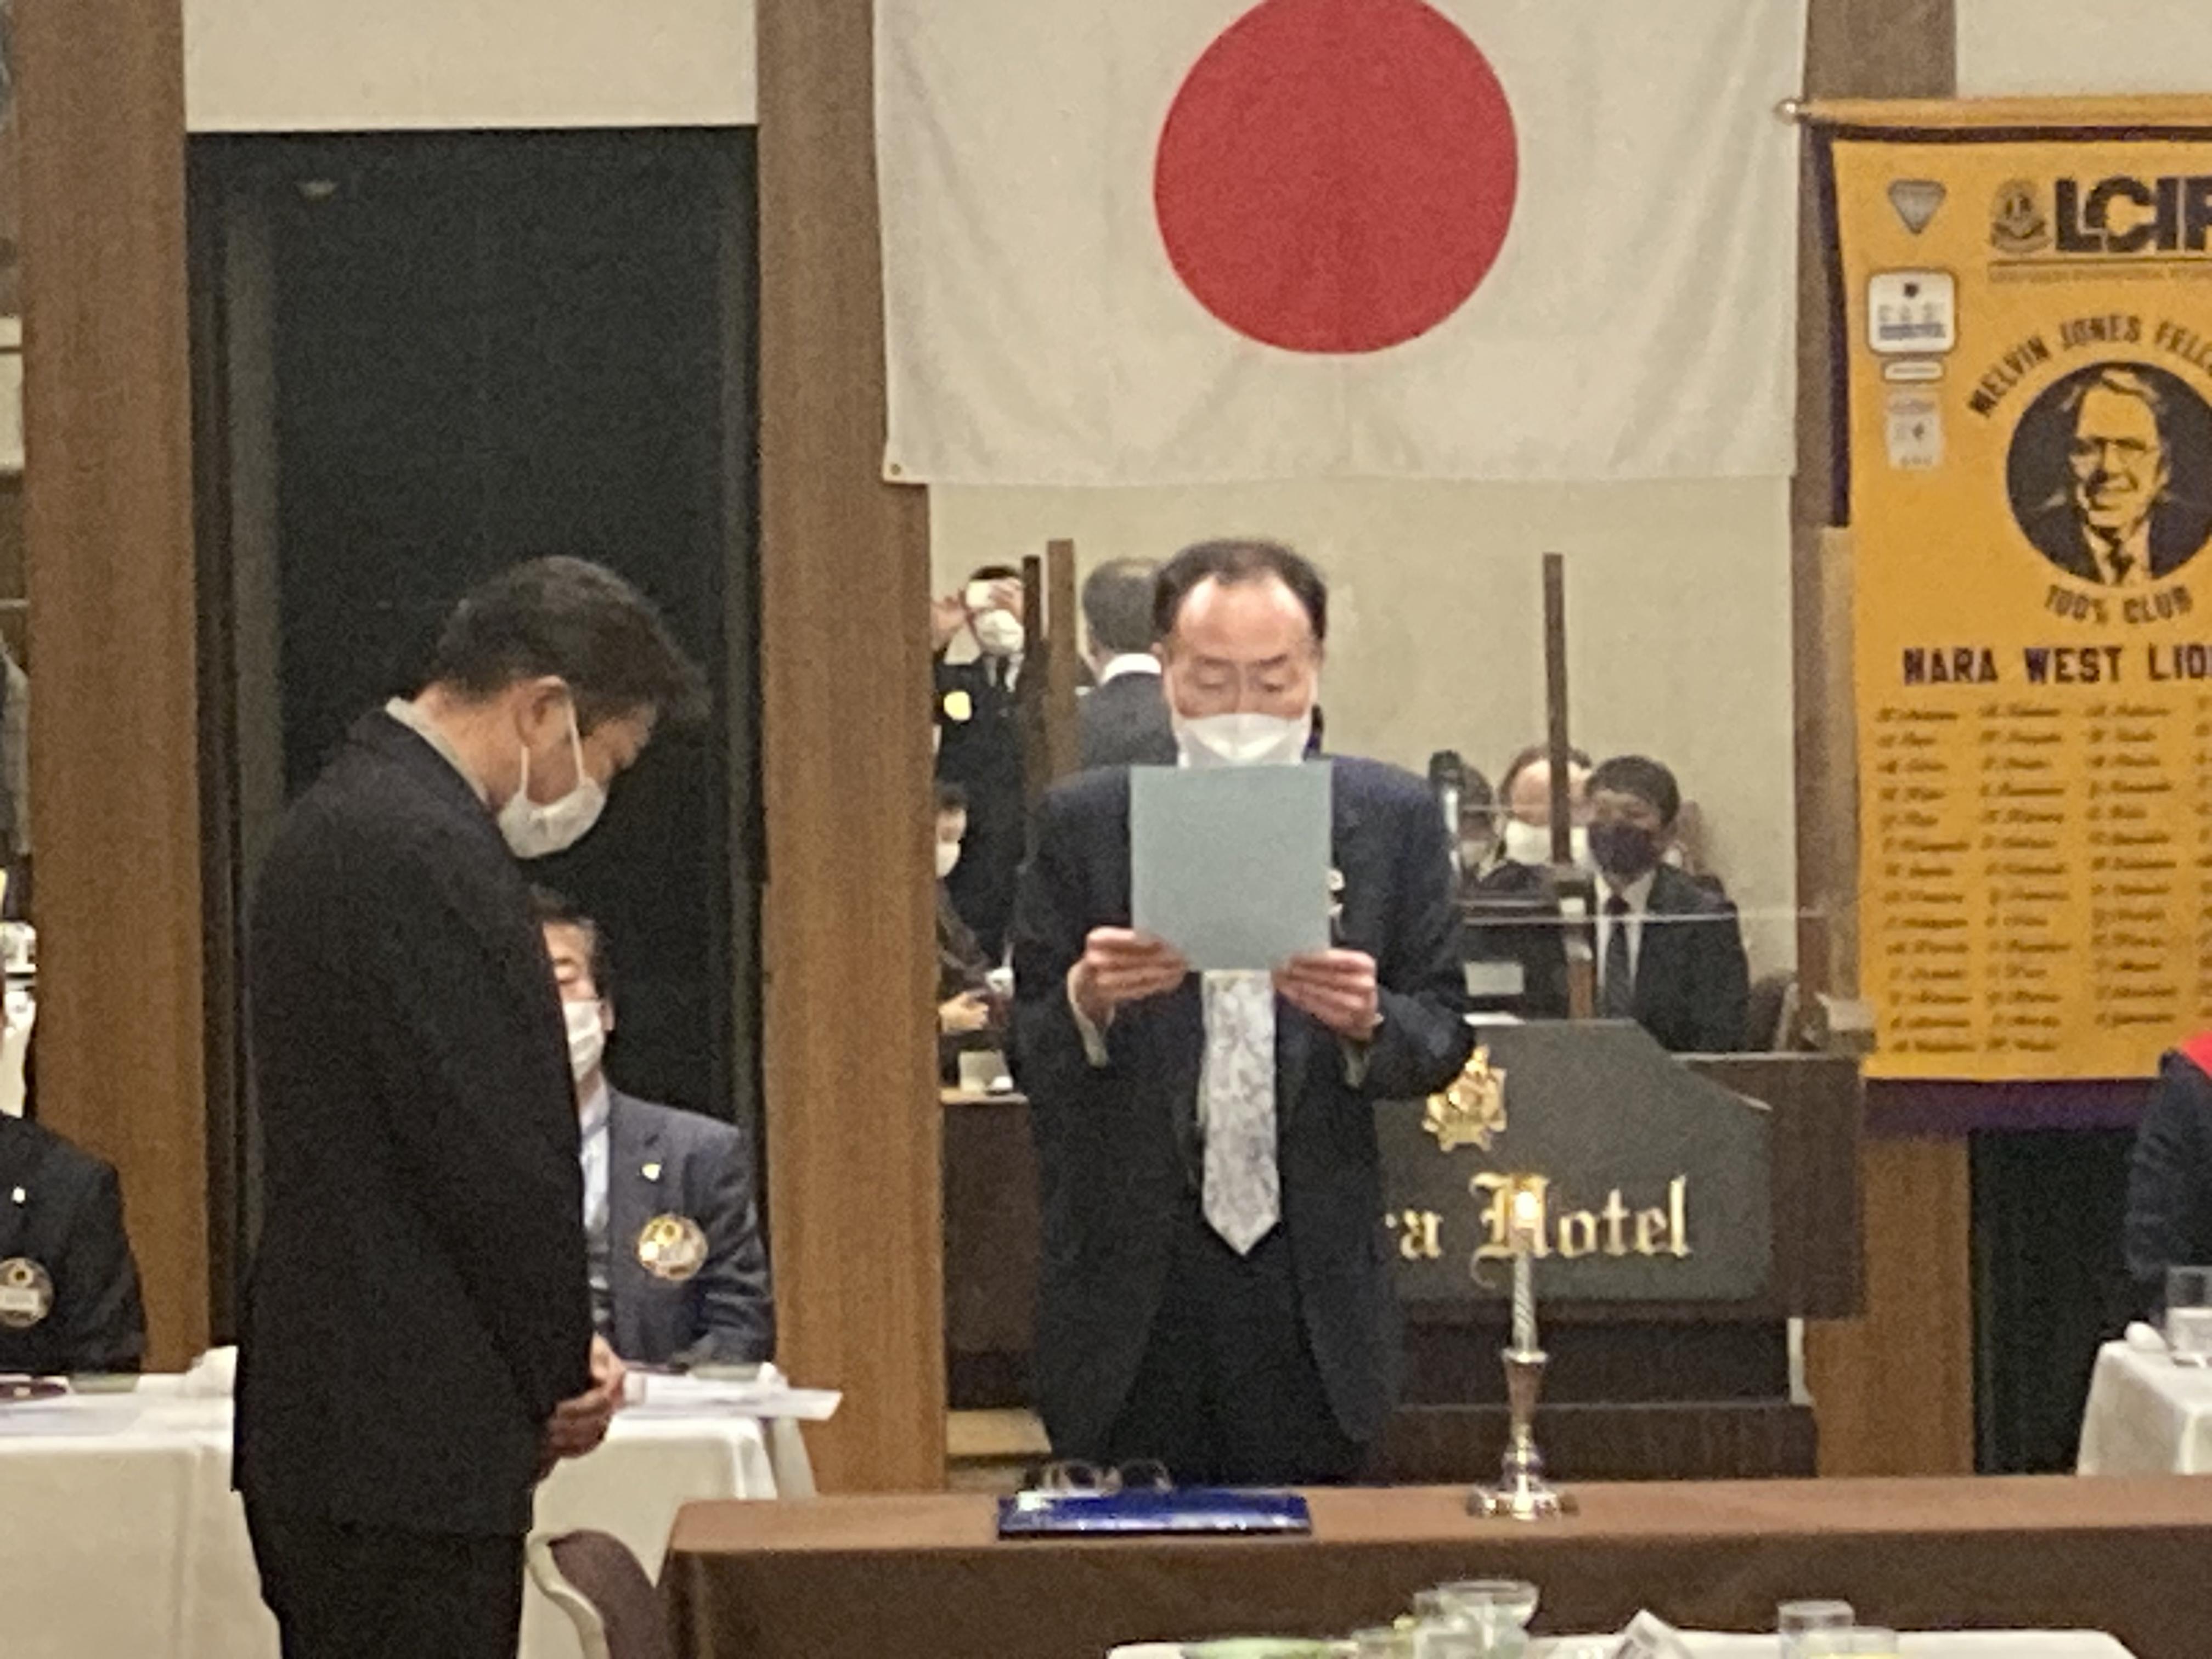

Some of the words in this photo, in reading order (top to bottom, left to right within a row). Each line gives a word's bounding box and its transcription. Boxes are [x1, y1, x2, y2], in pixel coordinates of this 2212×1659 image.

[1969, 335, 2051, 417] MELVIN
[2060, 314, 2142, 350] JONES
[2123, 585, 2193, 624] CLUB
[1903, 647, 1999, 685] NARA
[2023, 646, 2123, 685] WEST
[2147, 642, 2212, 681] LIO
[1468, 1171, 1693, 1289] Hotel
